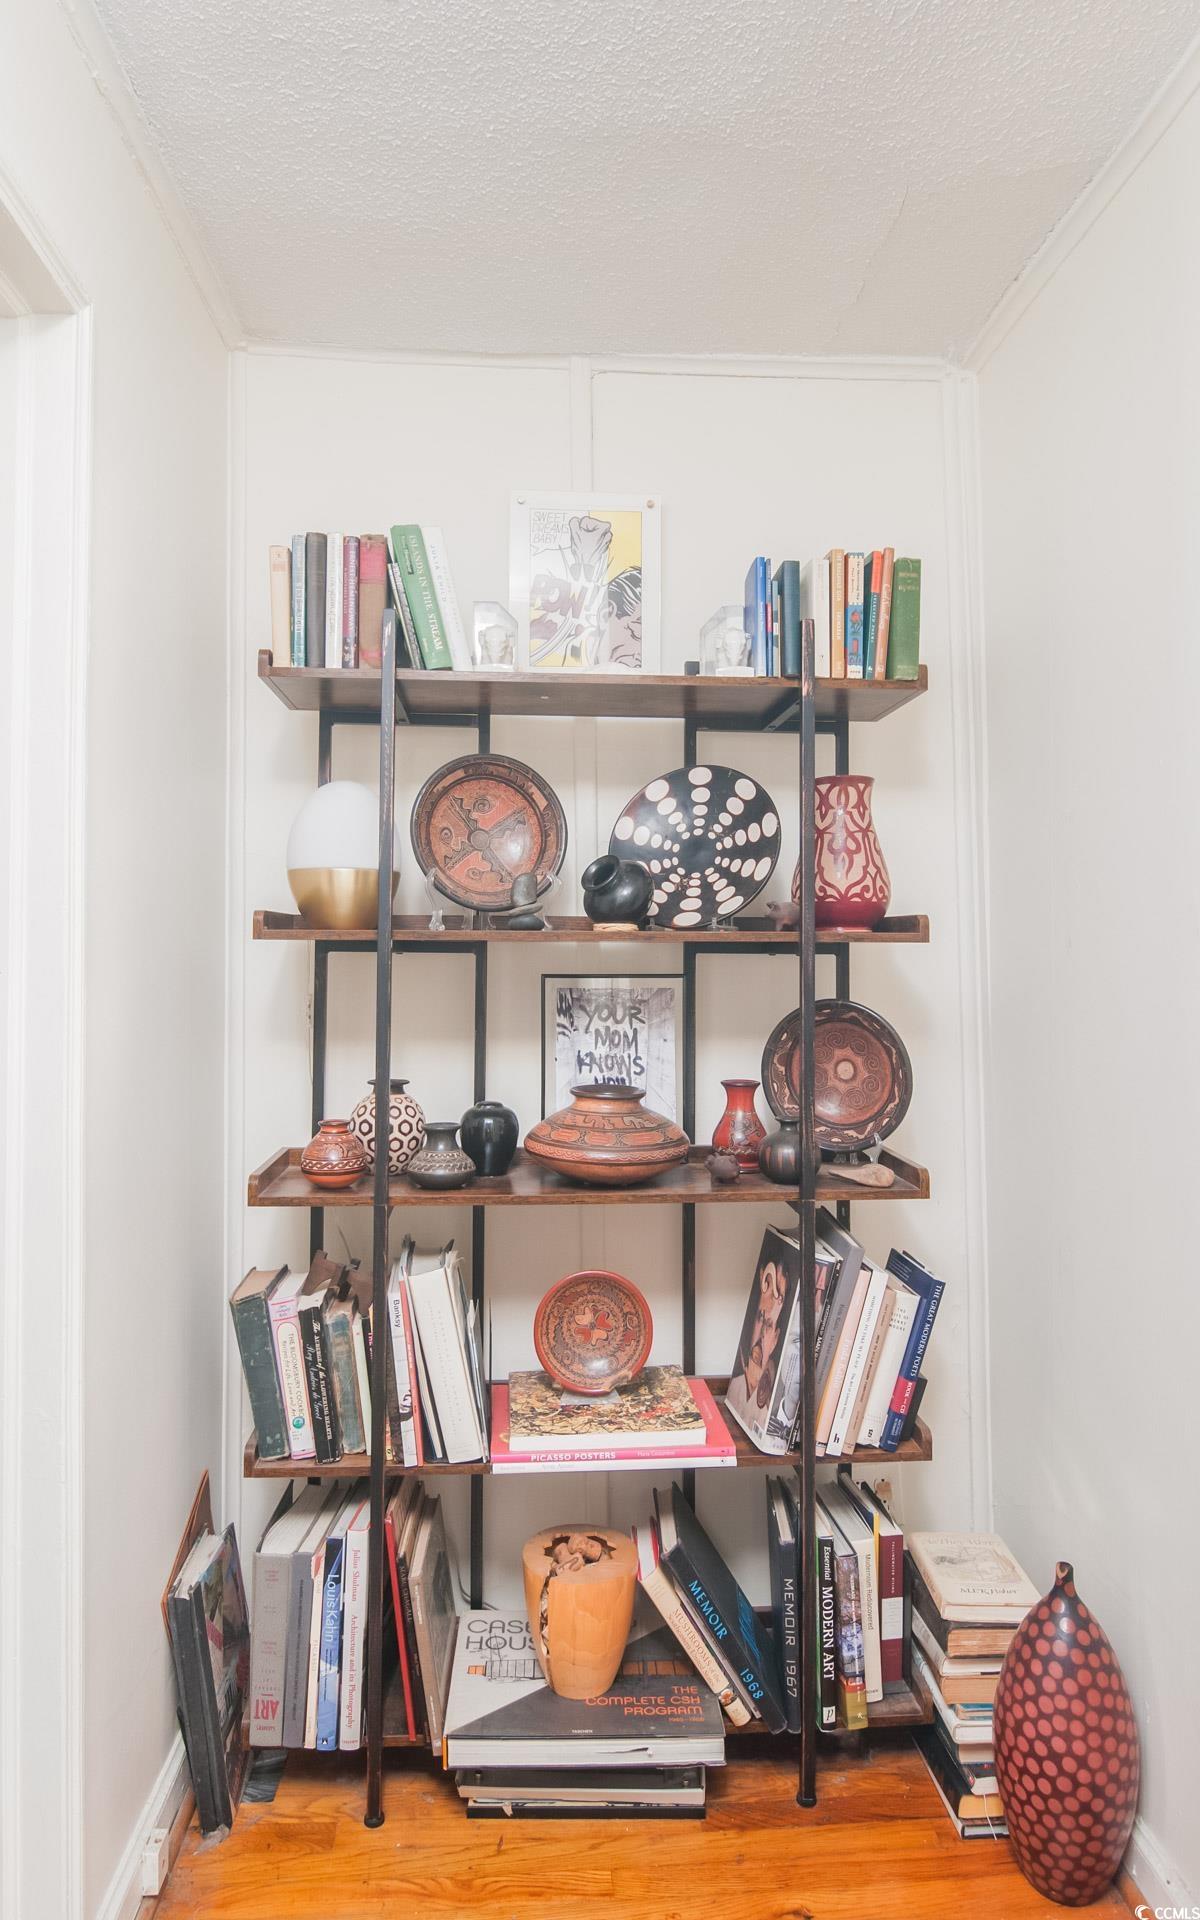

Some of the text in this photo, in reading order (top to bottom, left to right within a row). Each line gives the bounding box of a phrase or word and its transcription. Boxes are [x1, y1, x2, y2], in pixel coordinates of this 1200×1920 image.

[408, 535, 443, 651] ISLANDS IN THE STREAM
[579, 1001, 646, 1034] YOUR
[594, 1026, 639, 1056] MOM
[577, 1050, 646, 1080] KNOWS
[312, 1319, 320, 1333] The
[391, 1298, 403, 1328] Banksy
[909, 1284, 943, 1377] THE GREAT MODERN POETS
[287, 1332, 305, 1417] THE BLOOMSBURY COOKBO
[529, 1451, 616, 1462] PICASSO POSTERS
[352, 1549, 360, 1569] Julius
[398, 1566, 407, 1584] MARC
[326, 1574, 339, 1608] Louis
[351, 1570, 359, 1601] Shulman
[864, 1553, 874, 1630] Modernism Rediscovered
[325, 1609, 338, 1642] Kahn
[822, 1546, 834, 1680] Essential MODERN ART
[349, 1614, 358, 1656] Architecture
[672, 1608, 712, 1666] MUSHROOMS
[687, 1579, 765, 1700] MEMOIR 1968
[783, 1577, 796, 1697] MEMOIR 1967
[348, 1673, 356, 1682] its
[672, 1685, 698, 1694] THE
[254, 1699, 280, 1720] ART
[345, 1683, 356, 1728] Photography
[585, 1695, 701, 1706] COMPLETE CSH
[624, 1705, 703, 1716] PROGRAM
